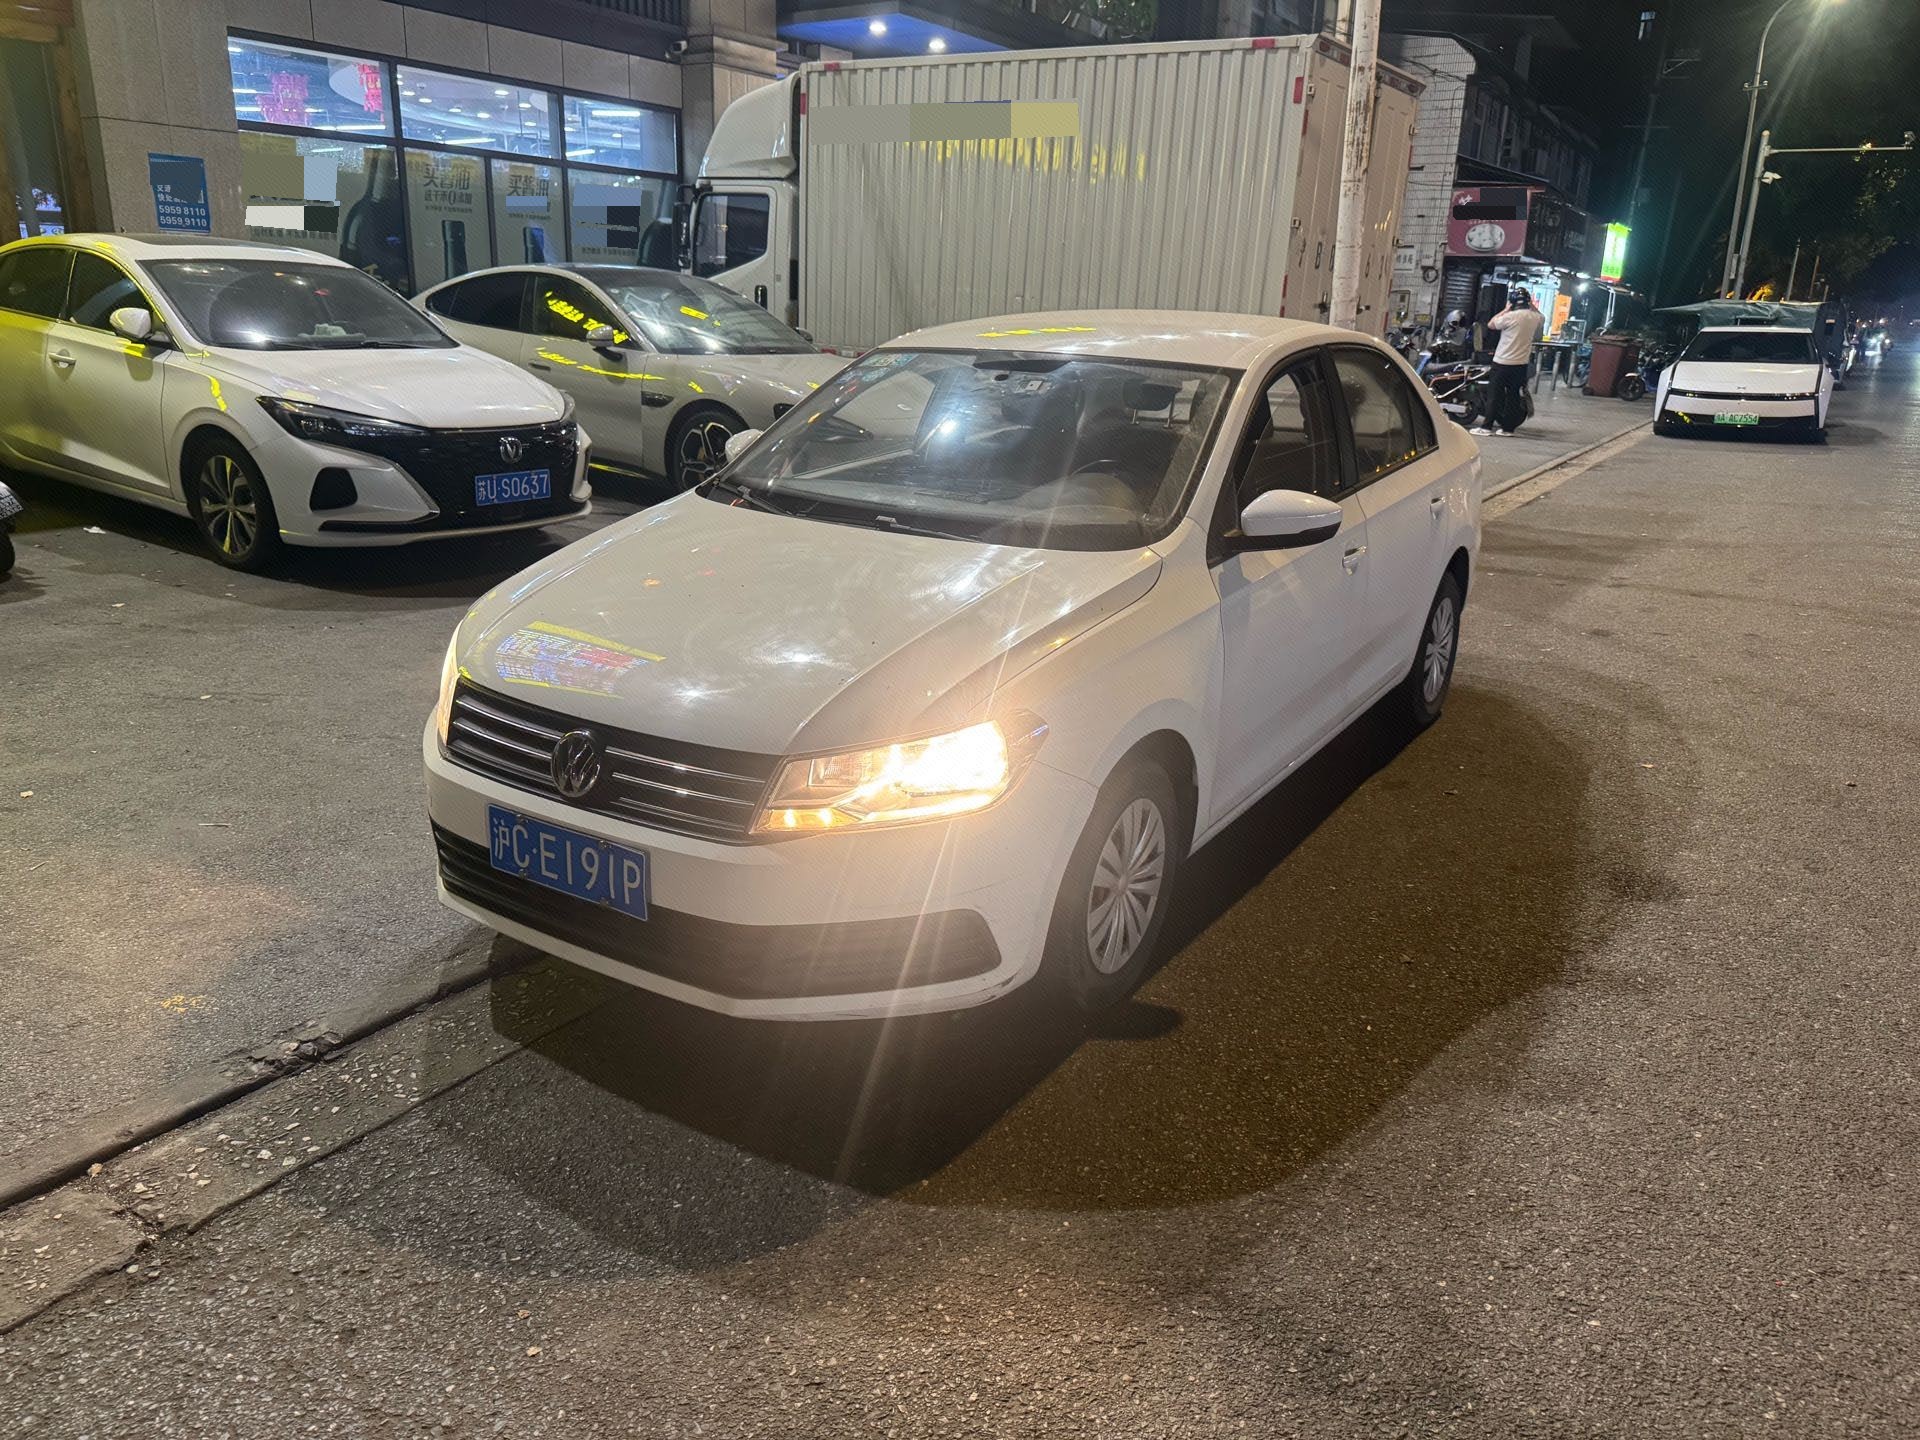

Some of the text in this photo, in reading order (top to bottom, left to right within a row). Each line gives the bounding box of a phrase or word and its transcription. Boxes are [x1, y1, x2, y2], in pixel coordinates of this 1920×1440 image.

[159, 205, 206, 216] 5959 8110
[160, 216, 207, 227] 5959 9110
